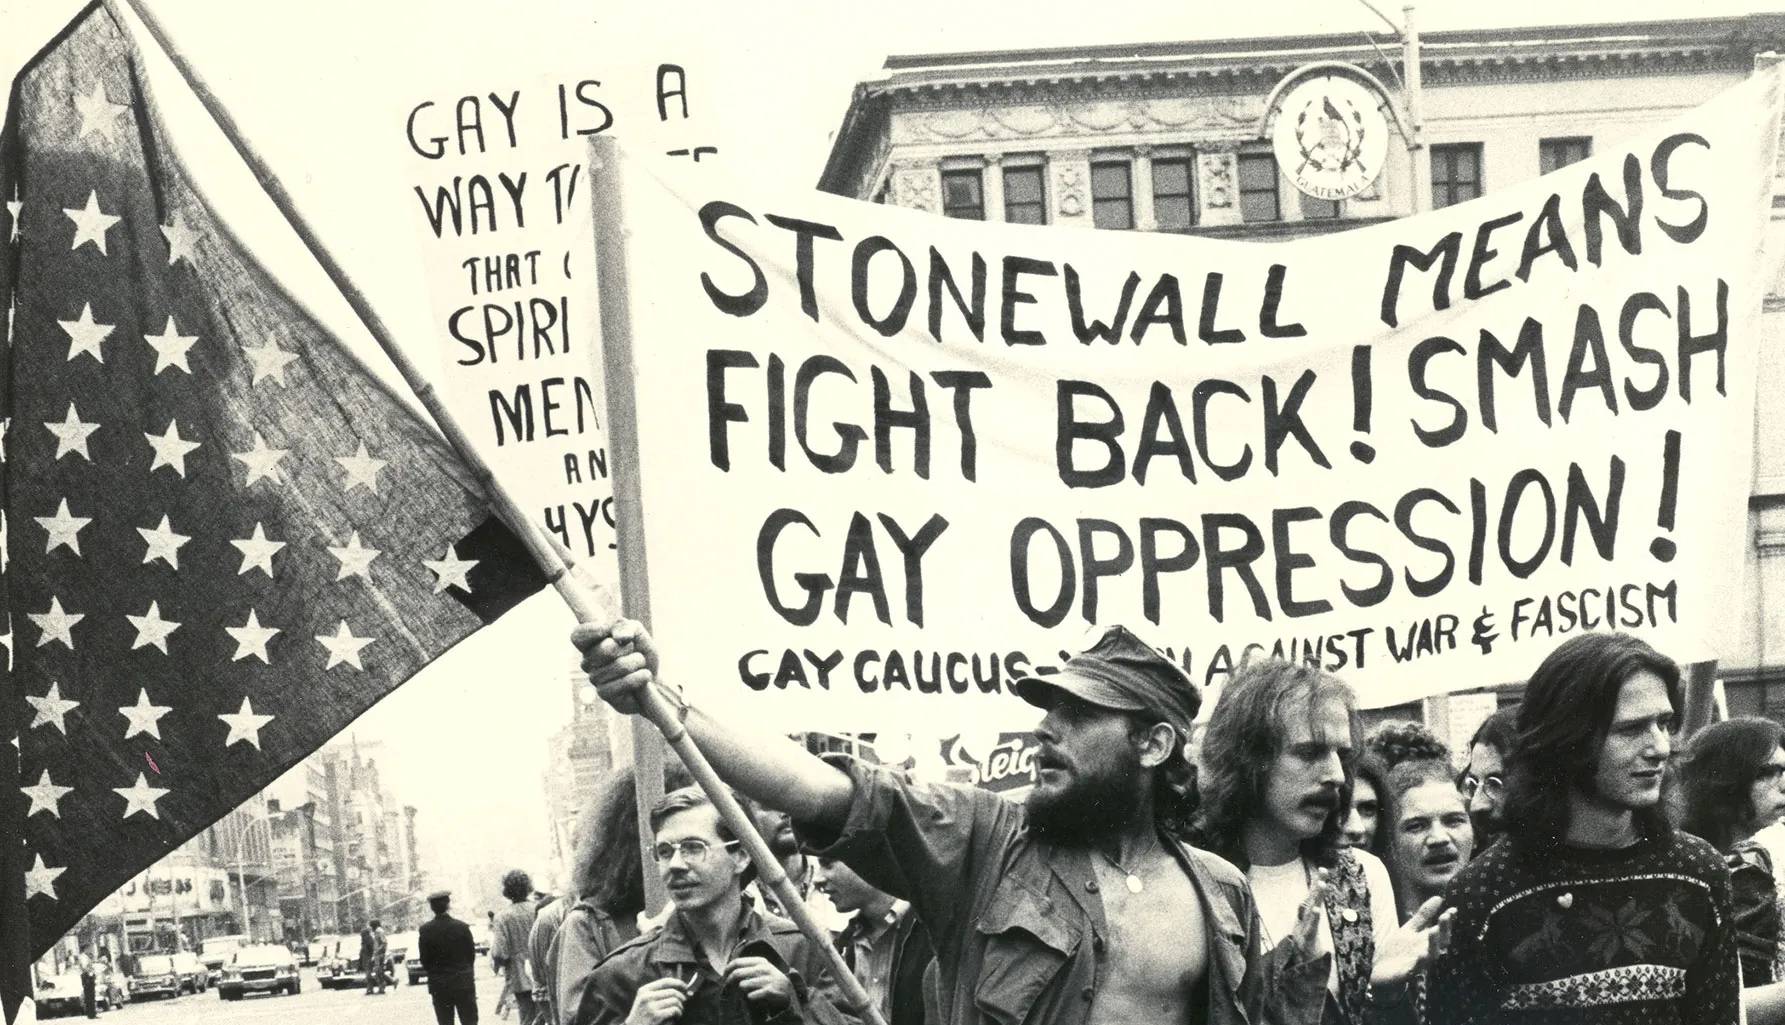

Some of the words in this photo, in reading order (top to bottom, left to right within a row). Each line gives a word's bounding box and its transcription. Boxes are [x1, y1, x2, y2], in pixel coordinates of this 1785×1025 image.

[406, 90, 520, 160] GAY
[558, 80, 614, 140] IS
[656, 63, 689, 122] A
[414, 172, 527, 239] WAY
[1296, 175, 1369, 198] GUATEMALA
[462, 250, 541, 296] THAT
[698, 201, 1308, 347] STONEWALL
[1380, 132, 1711, 329] MEANS
[448, 297, 570, 366] SPIRI
[488, 377, 600, 448] MEN
[706, 349, 993, 483] FIGHT
[1055, 345, 1376, 489] BACK!
[1407, 278, 1729, 448] SMASH
[563, 448, 608, 485] AN
[756, 508, 949, 629] GAY
[1010, 430, 1682, 629] OPPRESSION!
[738, 648, 843, 691] GAY
[1385, 614, 1460, 664] WAR
[1471, 605, 1500, 655] &
[1511, 579, 1677, 642] FASCISM
